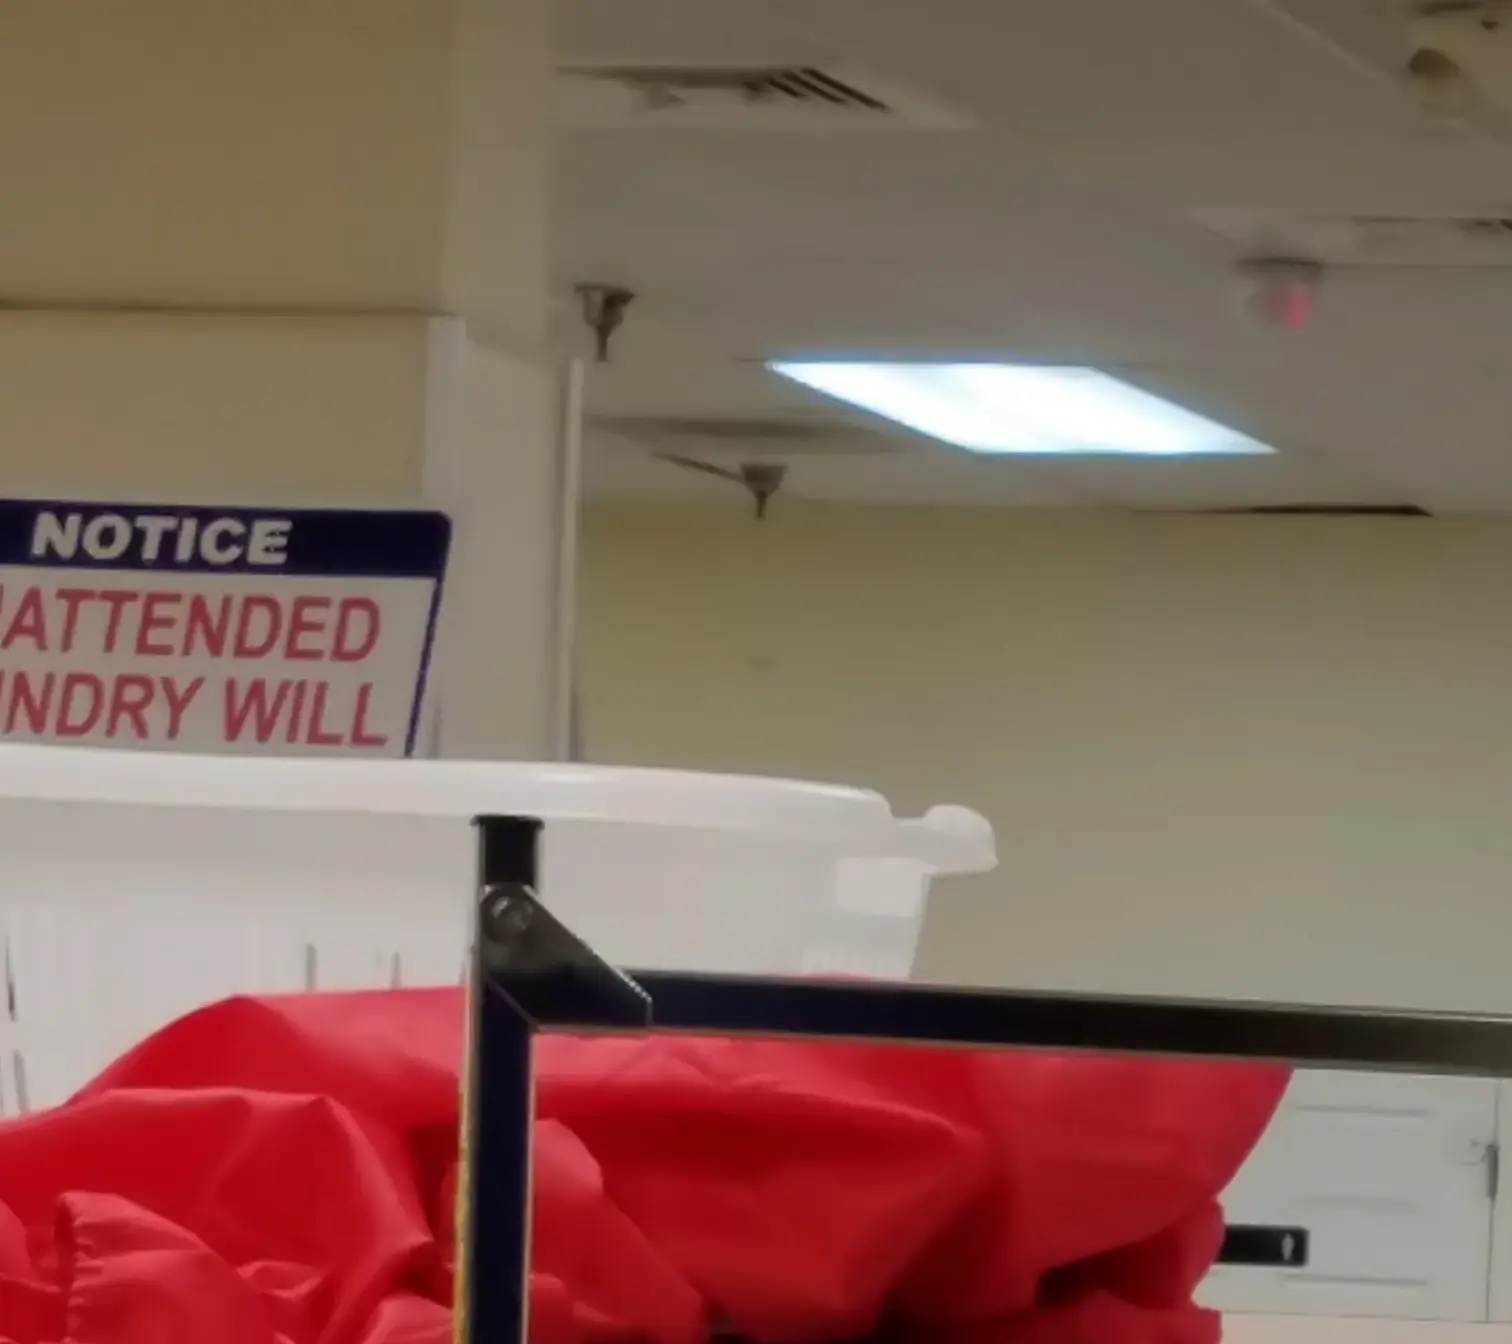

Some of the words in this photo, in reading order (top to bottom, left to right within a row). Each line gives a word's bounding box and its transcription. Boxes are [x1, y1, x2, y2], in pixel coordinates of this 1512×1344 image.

[30, 512, 293, 565] NOTICE
[0, 583, 382, 662] ATTENDED
[0, 669, 206, 739] NDRY
[223, 676, 389, 748] WILL
